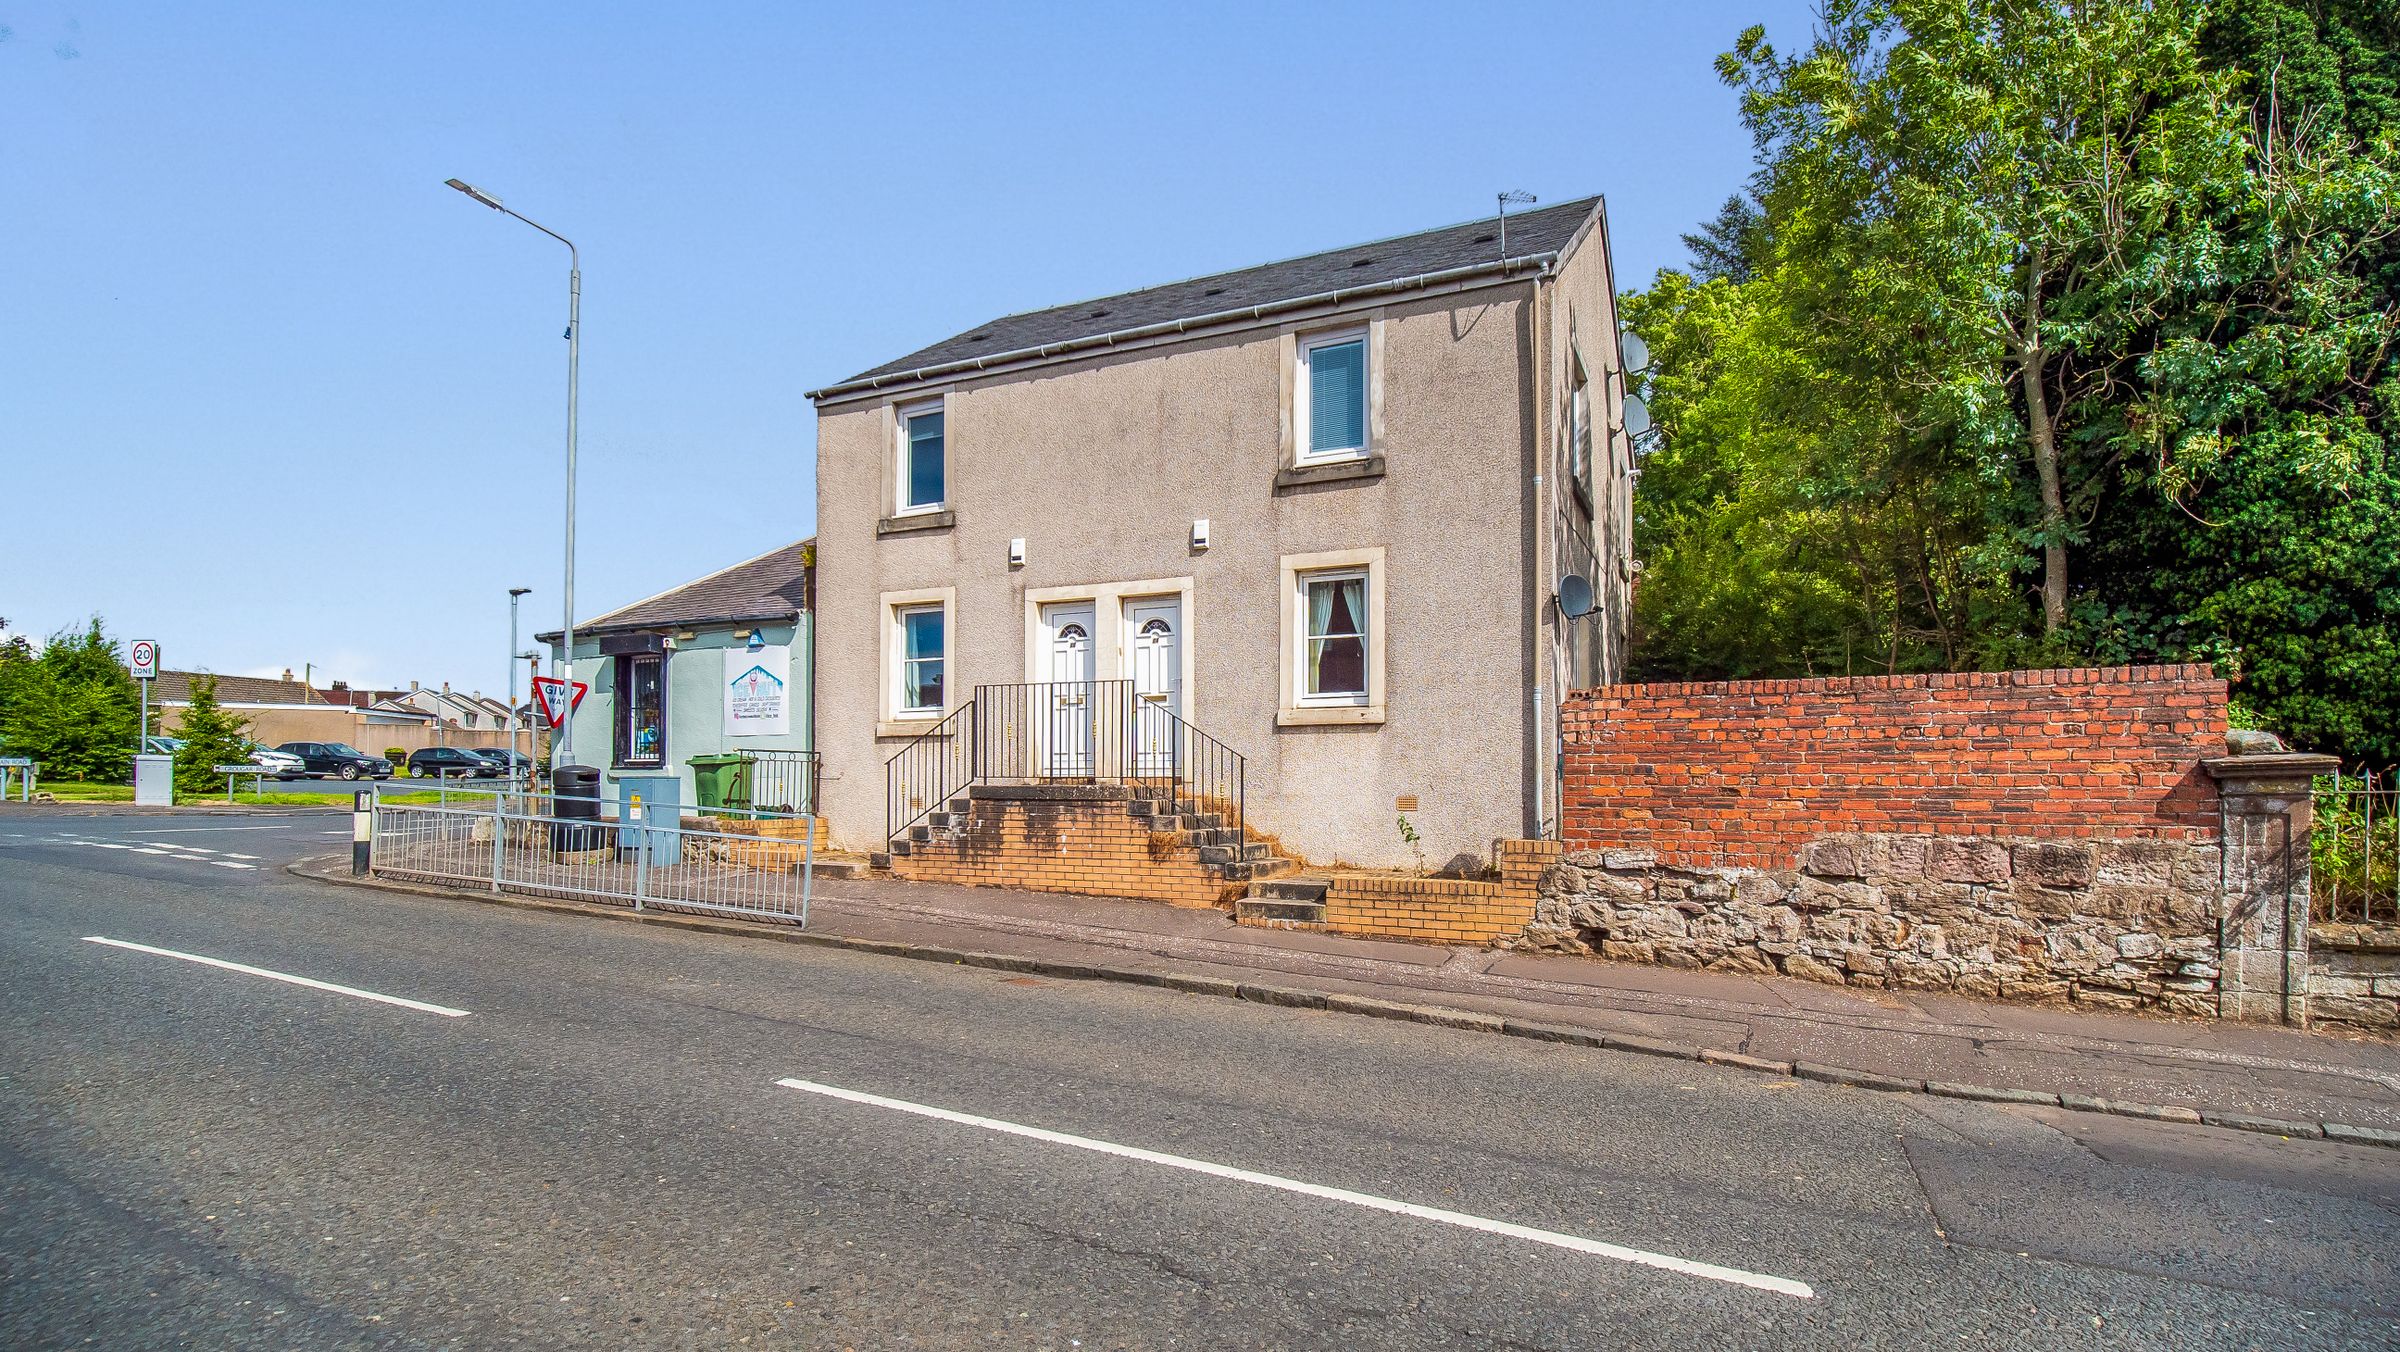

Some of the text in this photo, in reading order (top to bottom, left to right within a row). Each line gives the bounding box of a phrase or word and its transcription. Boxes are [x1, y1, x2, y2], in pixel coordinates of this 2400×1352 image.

[136, 649, 151, 660] 20
[133, 667, 153, 675] ZONE
[545, 684, 574, 697] GIV
